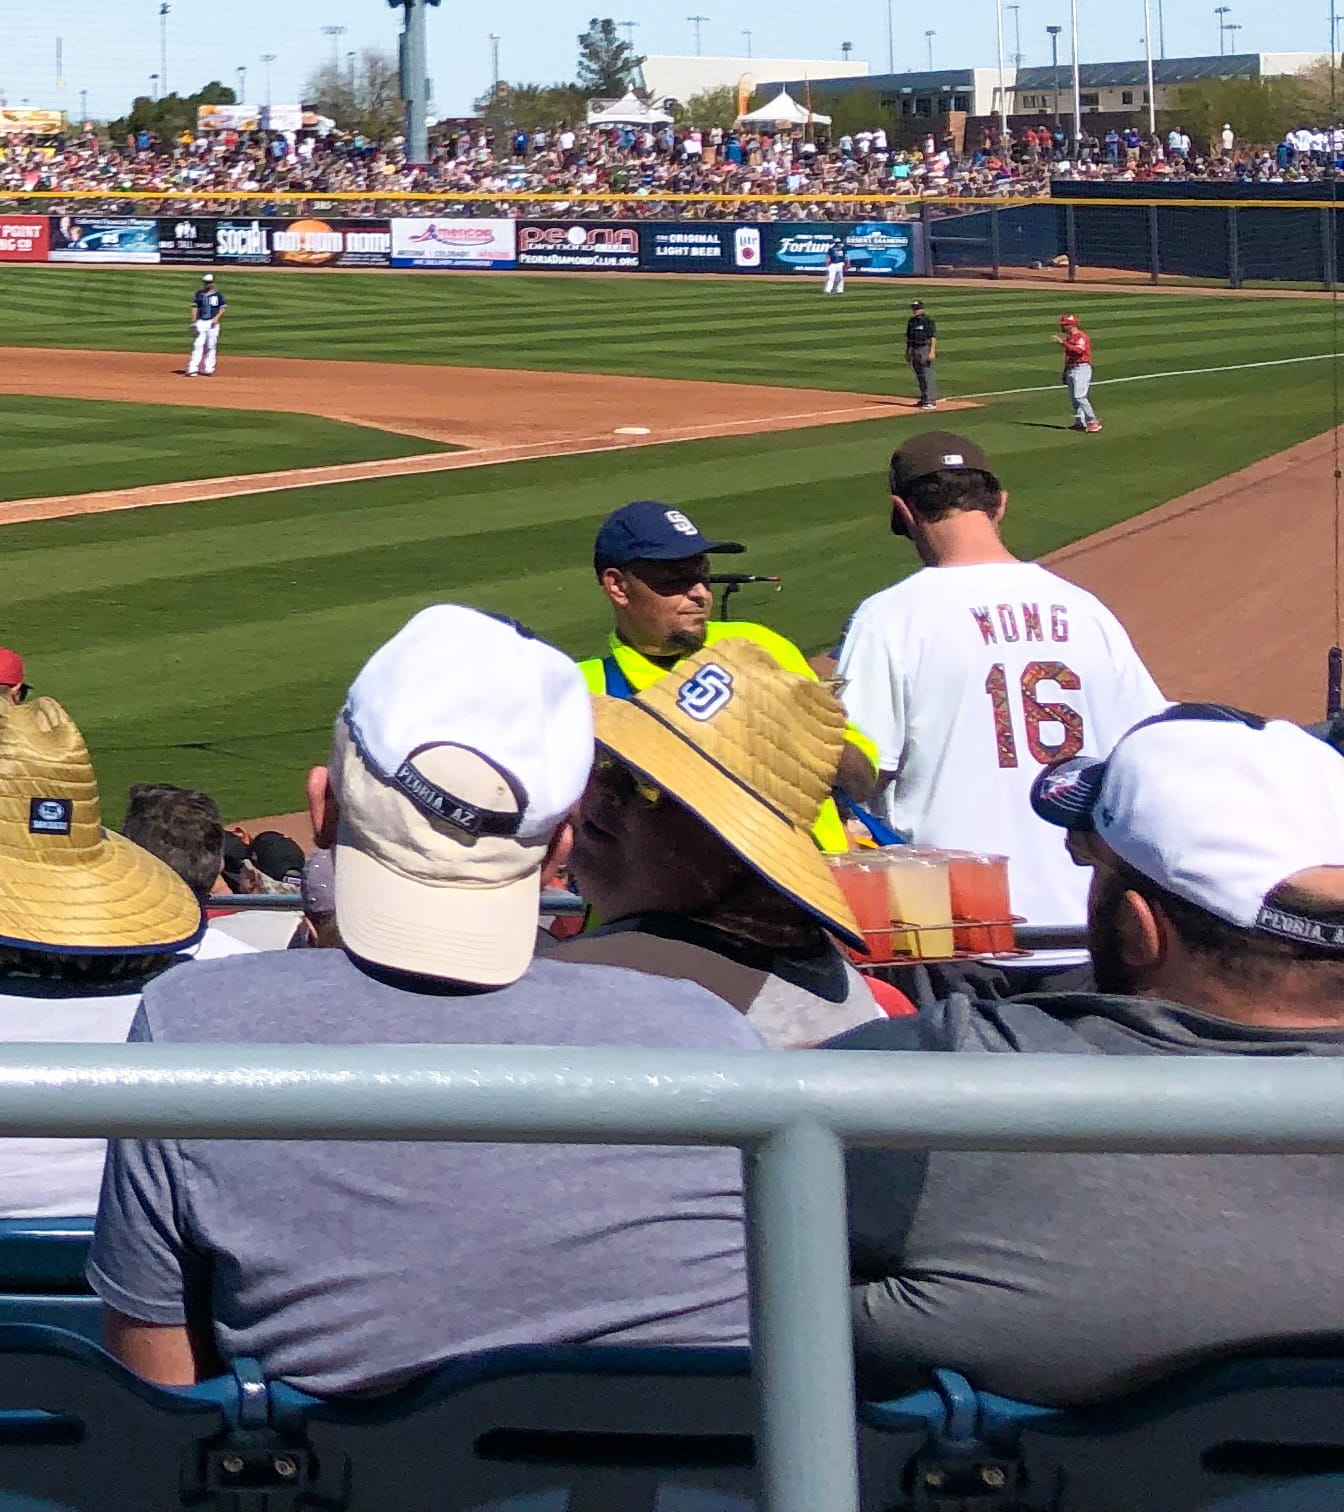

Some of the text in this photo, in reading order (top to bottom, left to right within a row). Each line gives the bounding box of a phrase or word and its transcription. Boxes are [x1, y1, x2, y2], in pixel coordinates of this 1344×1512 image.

[2, 225, 43, 238] POINT
[669, 234, 721, 244] ORIGINAL
[216, 226, 271, 255] SOCIAL
[780, 238, 835, 254] Fortun
[655, 247, 721, 257] LIGHT BEER
[969, 602, 1070, 646] WONG
[985, 661, 1085, 769] 16
[451, 808, 476, 826] AZ
